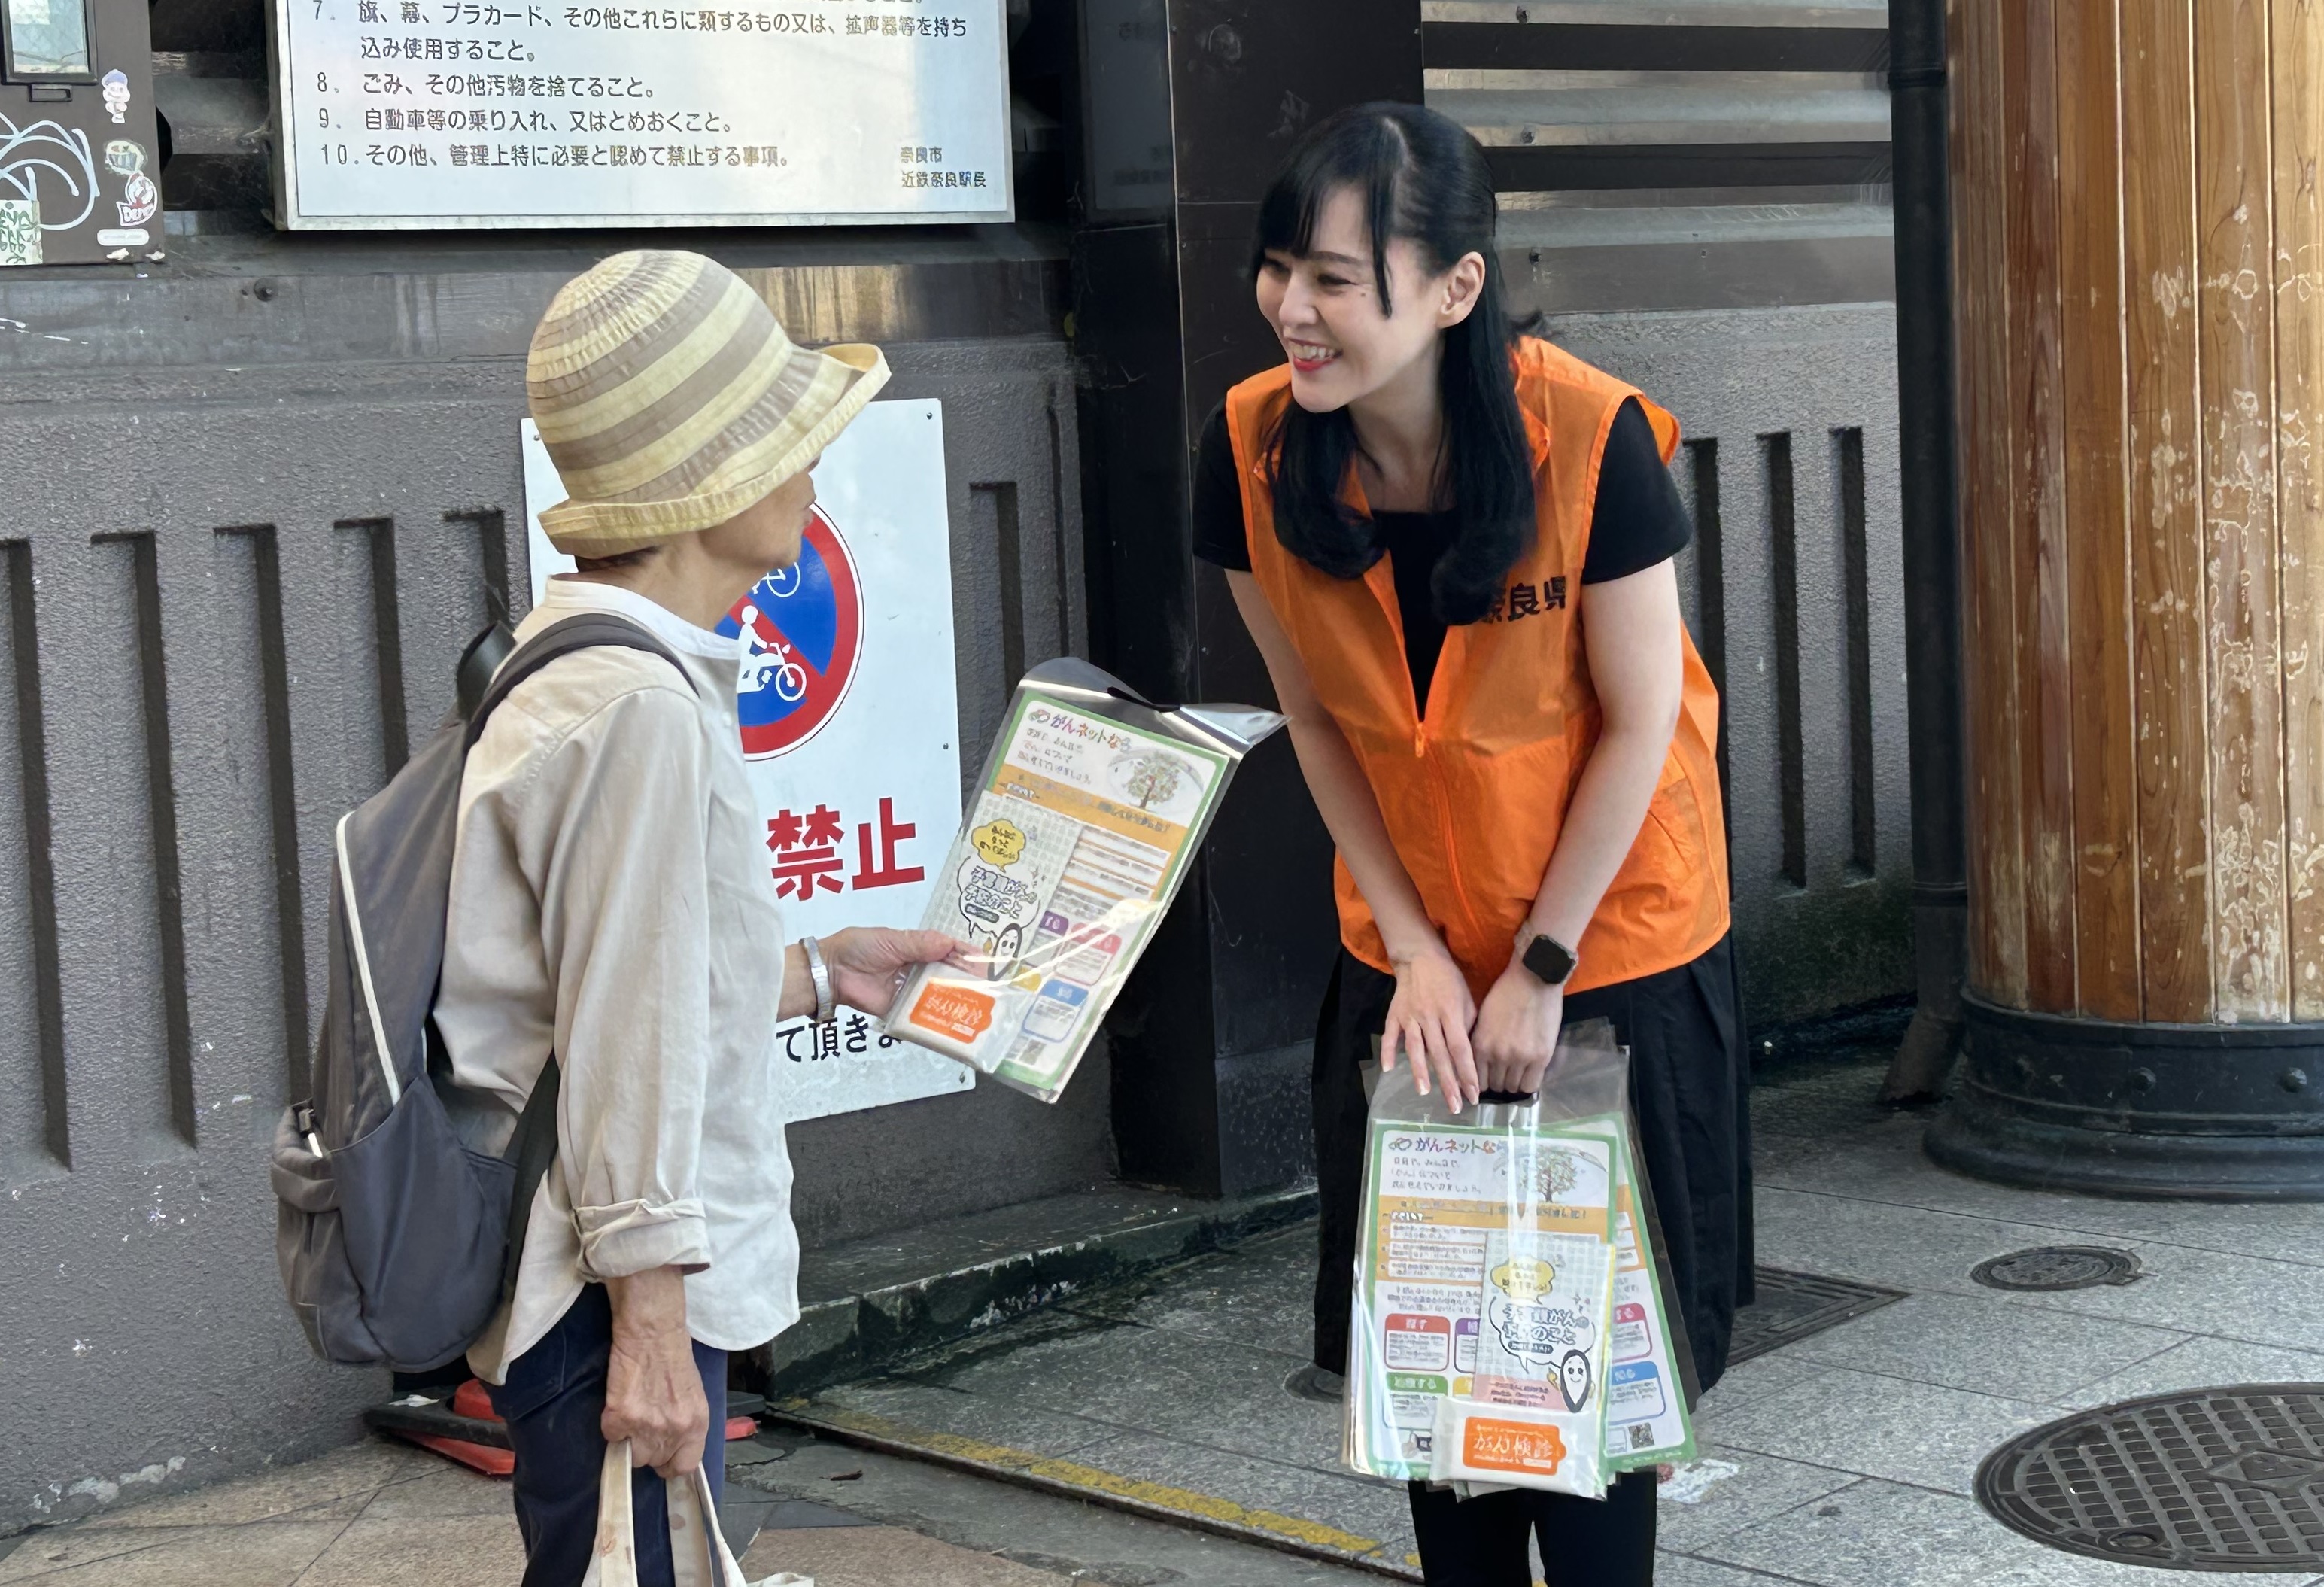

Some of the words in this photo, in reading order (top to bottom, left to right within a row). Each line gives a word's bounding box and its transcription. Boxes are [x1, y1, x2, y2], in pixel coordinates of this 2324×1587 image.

[360, 36, 535, 62] 込み使用すること。
[363, 73, 653, 98] ごみ、その他汚物を捨てること。
[366, 108, 731, 132] 自動車等の乗り入れ、又はとめおくこと。
[900, 146, 943, 163] 奈良市
[766, 797, 925, 901] 禁止
